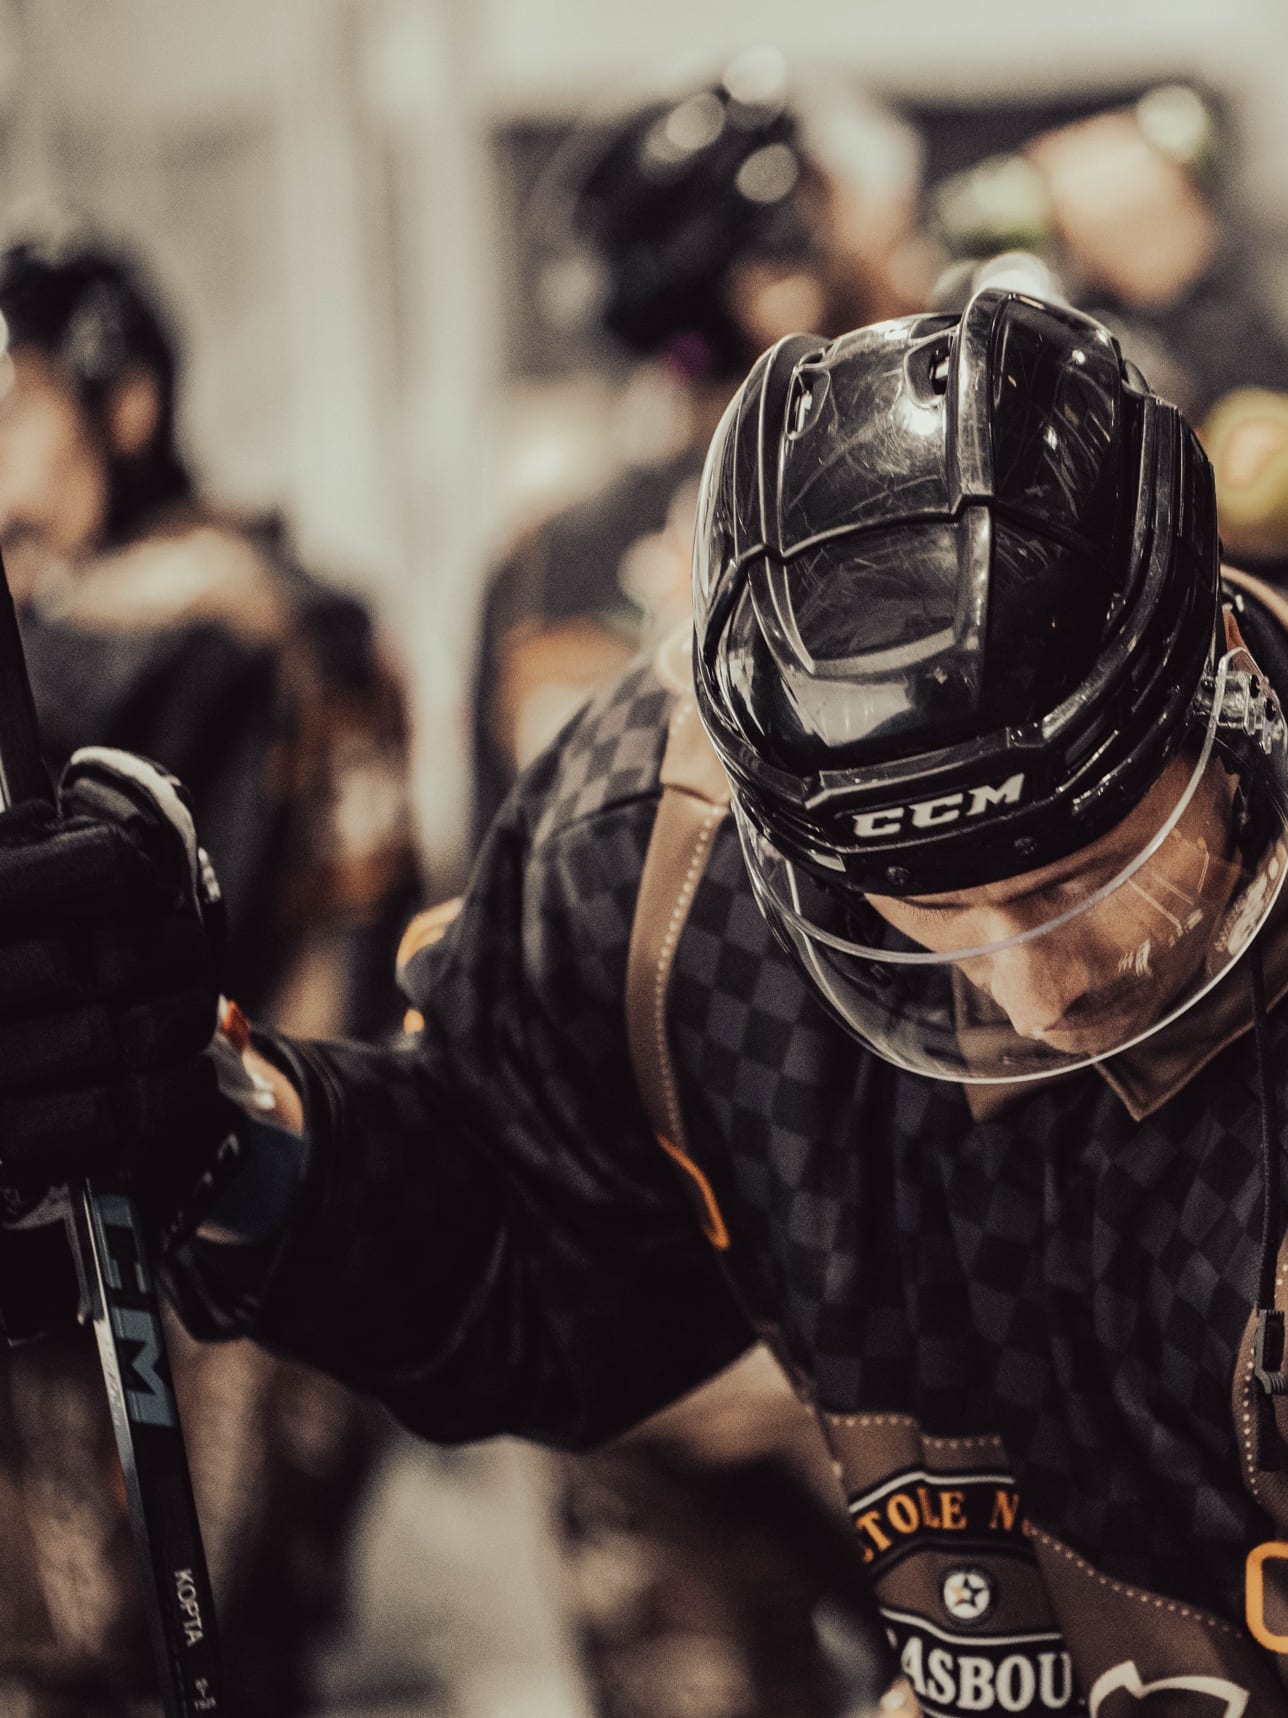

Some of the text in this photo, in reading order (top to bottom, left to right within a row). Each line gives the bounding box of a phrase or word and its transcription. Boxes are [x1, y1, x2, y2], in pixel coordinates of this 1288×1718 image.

[853, 773, 1025, 838] CCM
[857, 1487, 968, 1563] TOLE
[174, 1568, 204, 1648] KOPTA
[886, 1627, 1072, 1712] ASBOU
